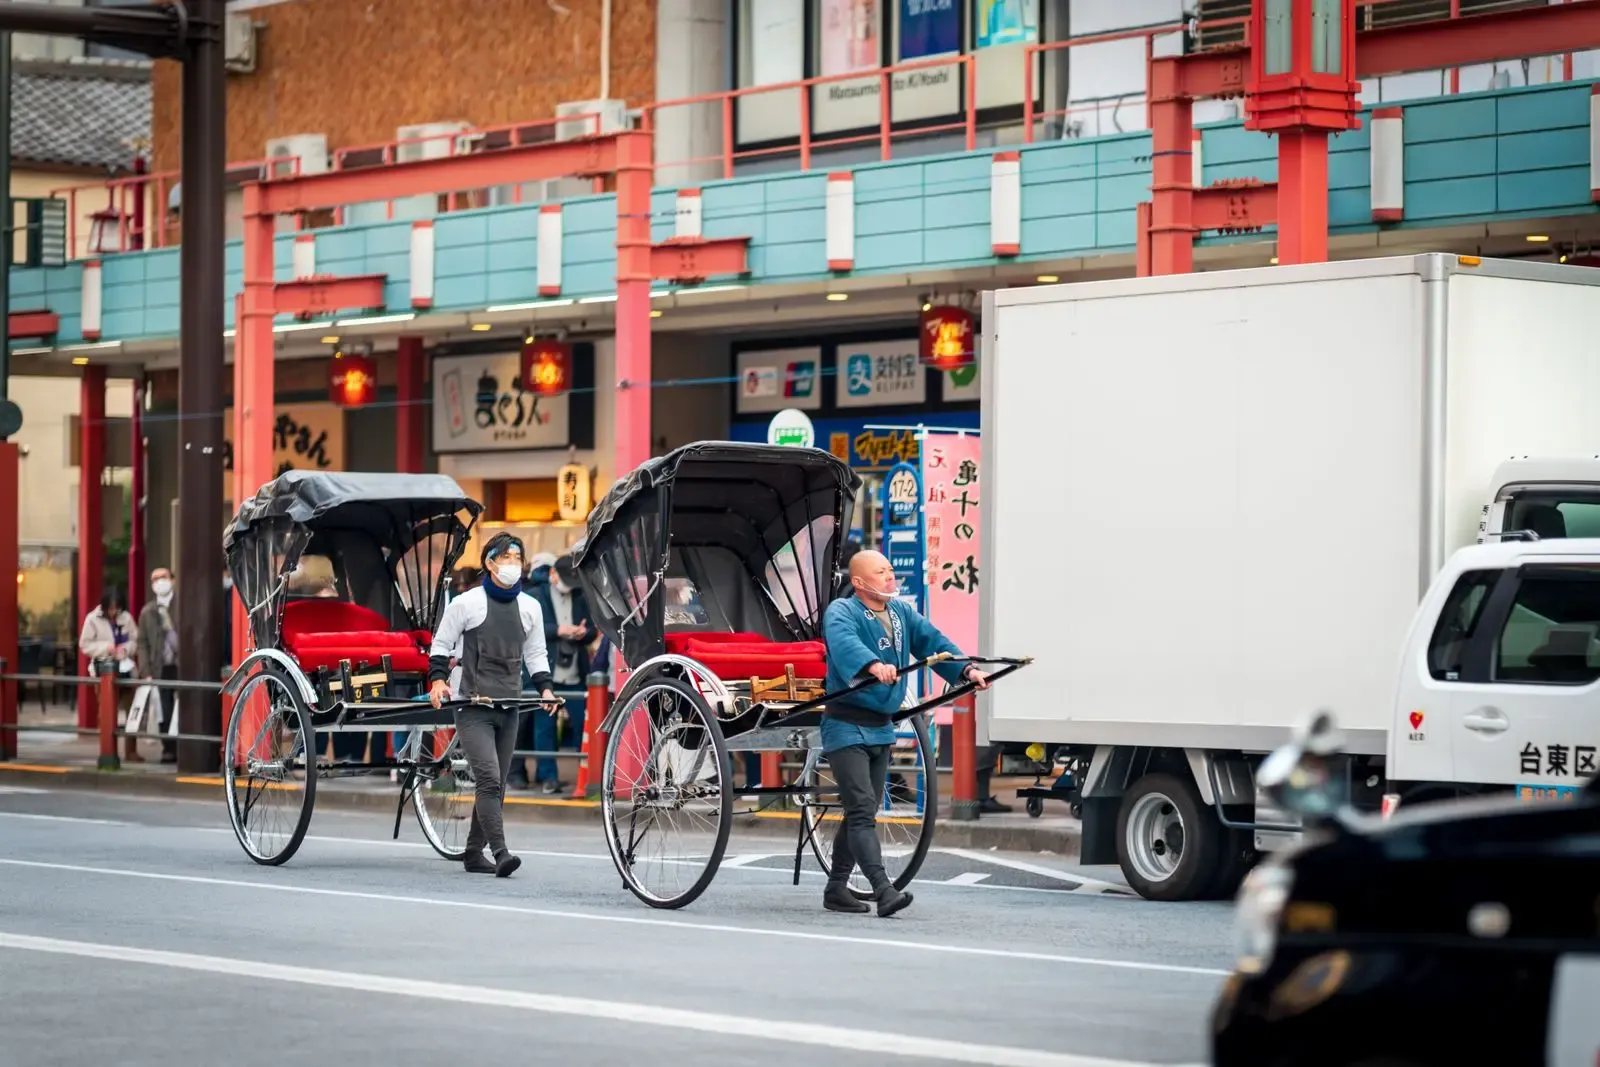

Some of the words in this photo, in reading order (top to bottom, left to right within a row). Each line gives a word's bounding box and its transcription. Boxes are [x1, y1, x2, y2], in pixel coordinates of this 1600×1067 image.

[875, 354, 916, 380] 支付宝
[892, 480, 914, 498] 17-2
[1520, 742, 1597, 778] 台東区
